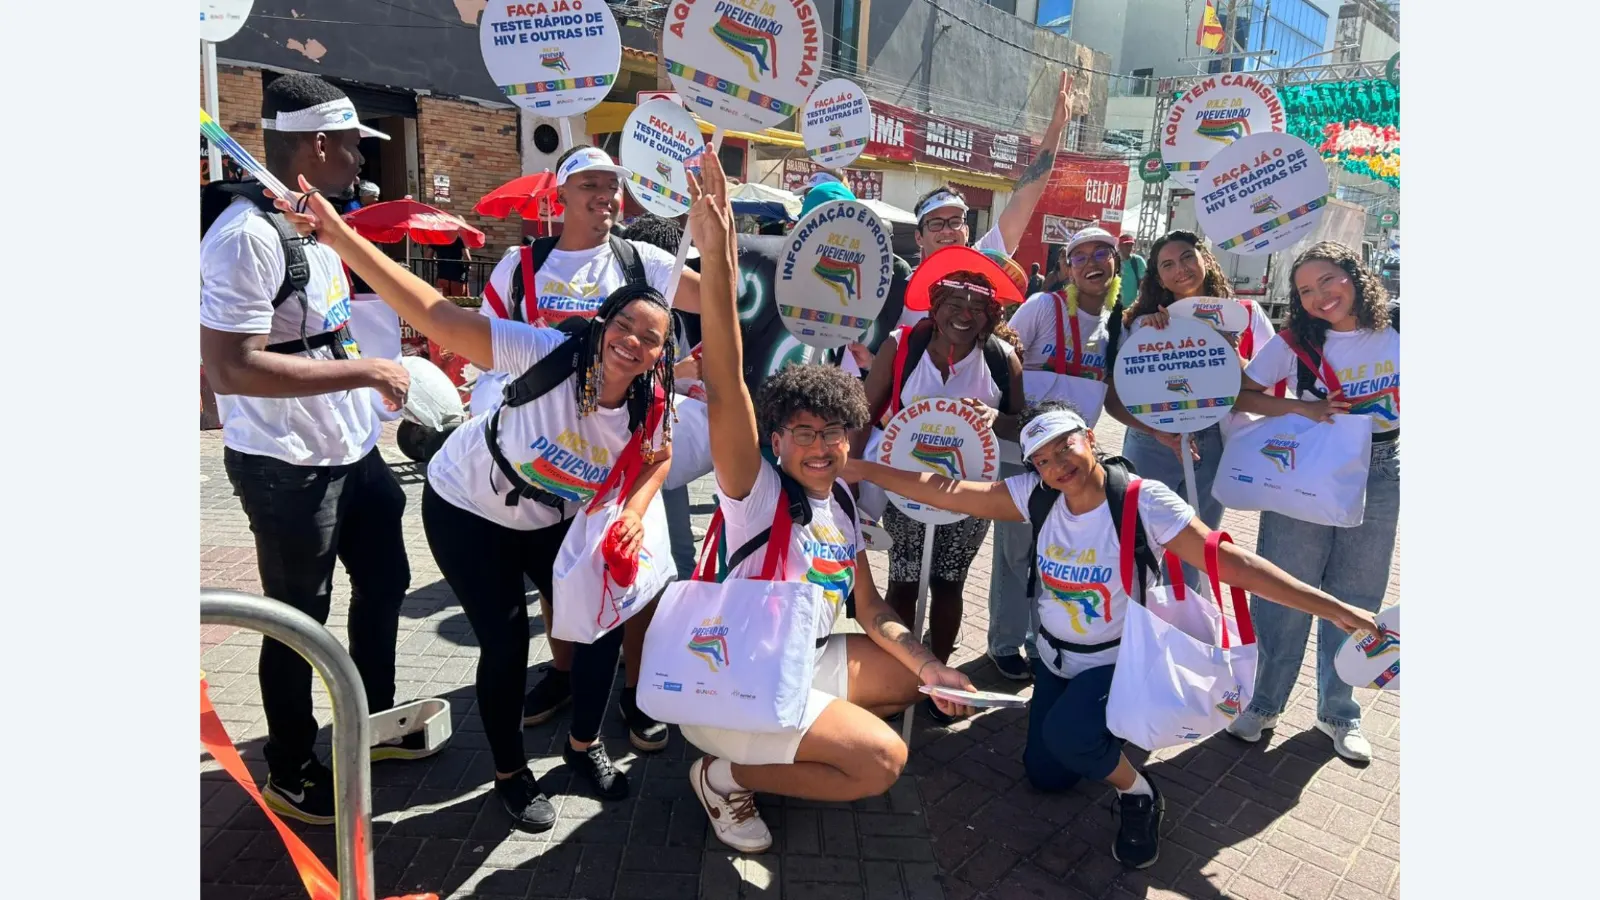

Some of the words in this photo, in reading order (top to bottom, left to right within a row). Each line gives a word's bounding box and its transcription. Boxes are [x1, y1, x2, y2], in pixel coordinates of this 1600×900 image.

[507, 3, 547, 17] FAÇA
[551, 0, 570, 14] JÁ
[572, 1, 583, 10] O
[491, 20, 532, 33] TESTE
[534, 15, 583, 28] RÁPIDO
[585, 12, 603, 23] DE
[494, 35, 516, 46] HIV
[519, 33, 528, 43] E
[530, 28, 583, 42] OUTRAS
[585, 26, 605, 36] IST
[670, 0, 697, 39] AQ
[789, 0, 818, 87] ISINHA!
[806, 109, 826, 119] TESTE
[827, 100, 852, 114] RÁPIDO
[853, 98, 863, 107] DE
[815, 97, 834, 109] FAÇA
[836, 92, 845, 103] JÁ
[1165, 105, 1185, 146] AQUI
[1181, 78, 1216, 104] TEM
[825, 111, 851, 122] OUTRAS
[852, 107, 863, 115] IST
[636, 121, 661, 140] TESTE
[662, 135, 692, 156] RÁPIDO
[649, 115, 673, 136] FAÇA
[675, 130, 687, 143] JÁ
[689, 138, 695, 146] O
[926, 121, 974, 150] MINI
[633, 131, 648, 144] HIV
[649, 139, 655, 148] E
[656, 143, 685, 163] OUTRA
[925, 145, 972, 163] MARKET
[1202, 182, 1239, 203] TESTE
[1240, 159, 1285, 186] RÁPIDO
[1287, 149, 1305, 163] DE
[1213, 163, 1250, 187] FAÇA
[1254, 151, 1271, 167] JÁ
[1273, 148, 1282, 157] O
[1085, 178, 1108, 204] GELO
[1206, 198, 1226, 214] HIV
[1228, 194, 1237, 203] E
[1239, 170, 1288, 198] OUTRAS
[1289, 159, 1308, 174] IST
[783, 203, 855, 280] INFORMAÇÃO
[857, 209, 867, 222] É
[866, 218, 891, 298] PROTEÇÃO
[1123, 354, 1159, 365] TESTE
[1163, 347, 1206, 360] RÁPIDO
[1209, 347, 1225, 356] DE
[1138, 341, 1174, 353] FAÇA
[1178, 337, 1195, 349] JÁ
[1198, 339, 1206, 347] O
[1125, 365, 1145, 375] HIV
[1148, 364, 1155, 373] E
[1158, 359, 1205, 372] OUTRAS
[1209, 357, 1226, 366] IST
[881, 424, 901, 465] AQUI
[898, 401, 931, 424] TEM
[935, 400, 995, 480] CAMISINHA!
